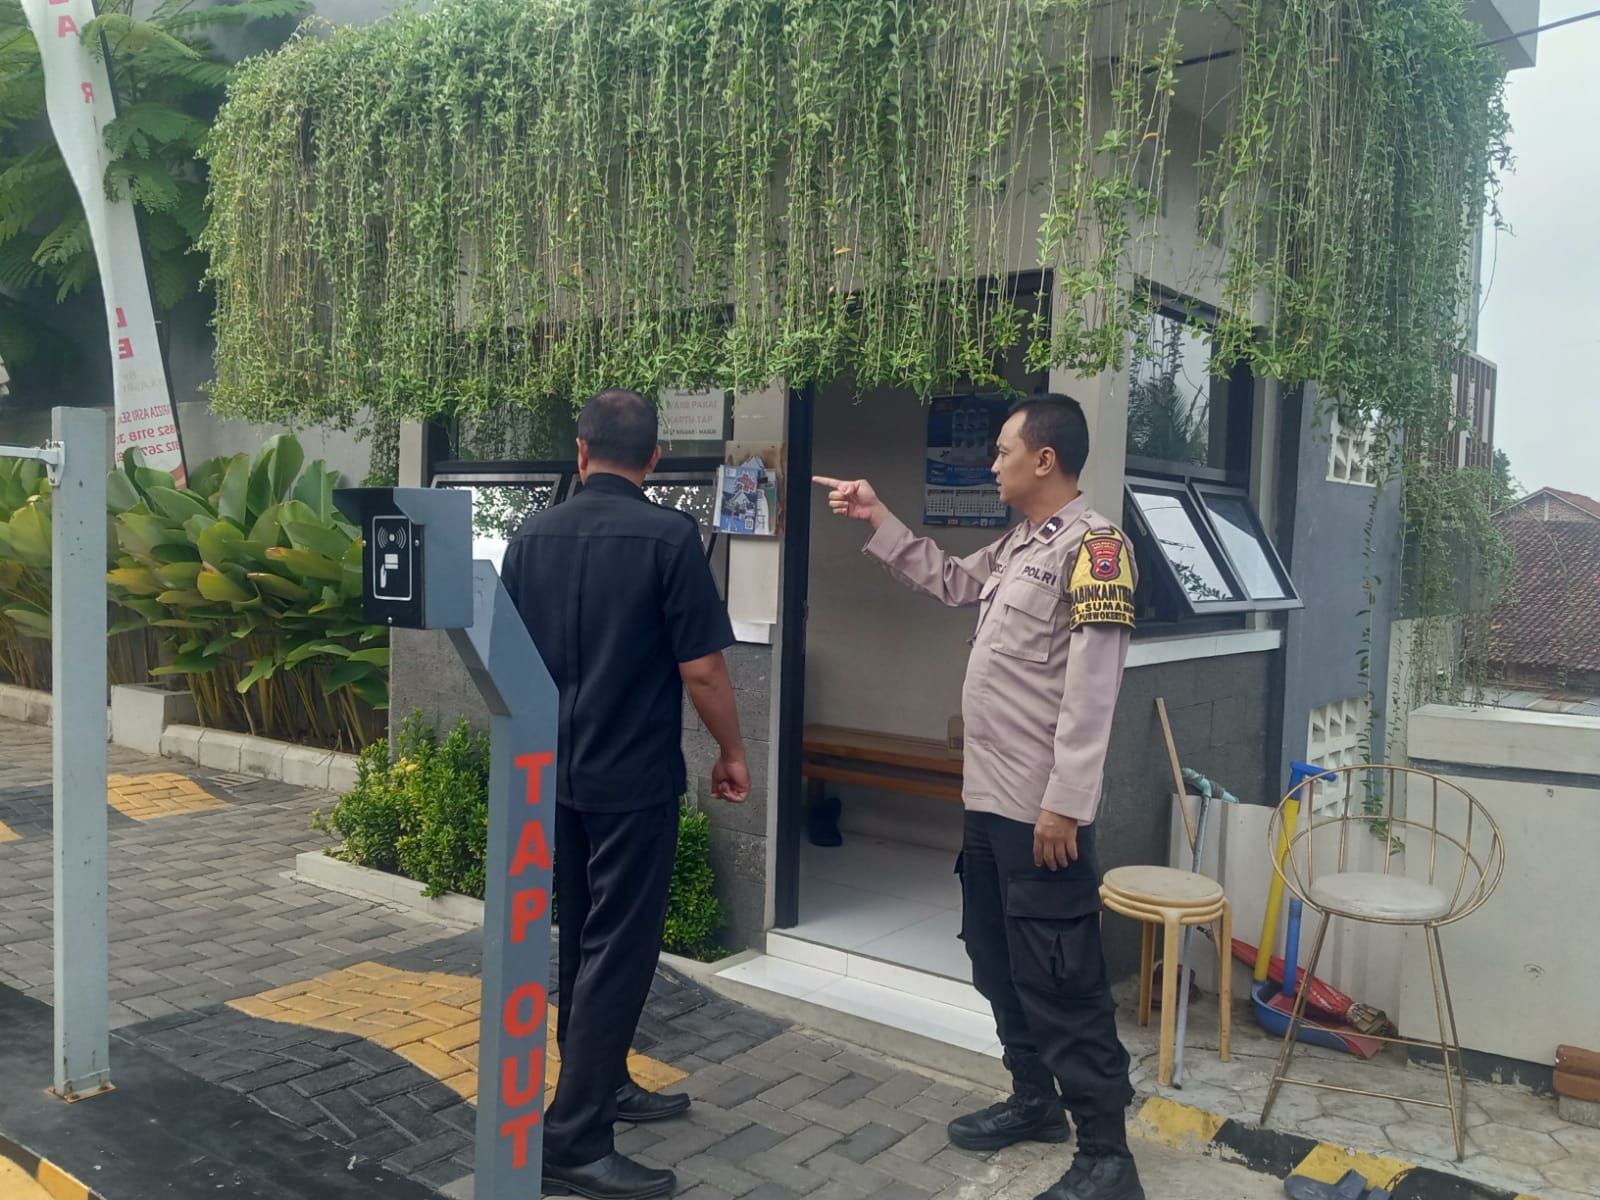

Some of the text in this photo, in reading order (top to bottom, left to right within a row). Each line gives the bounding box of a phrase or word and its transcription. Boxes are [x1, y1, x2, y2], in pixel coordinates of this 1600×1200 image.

[1023, 565, 1057, 586] POLRI
[500, 752, 554, 1169] TAP OUT
